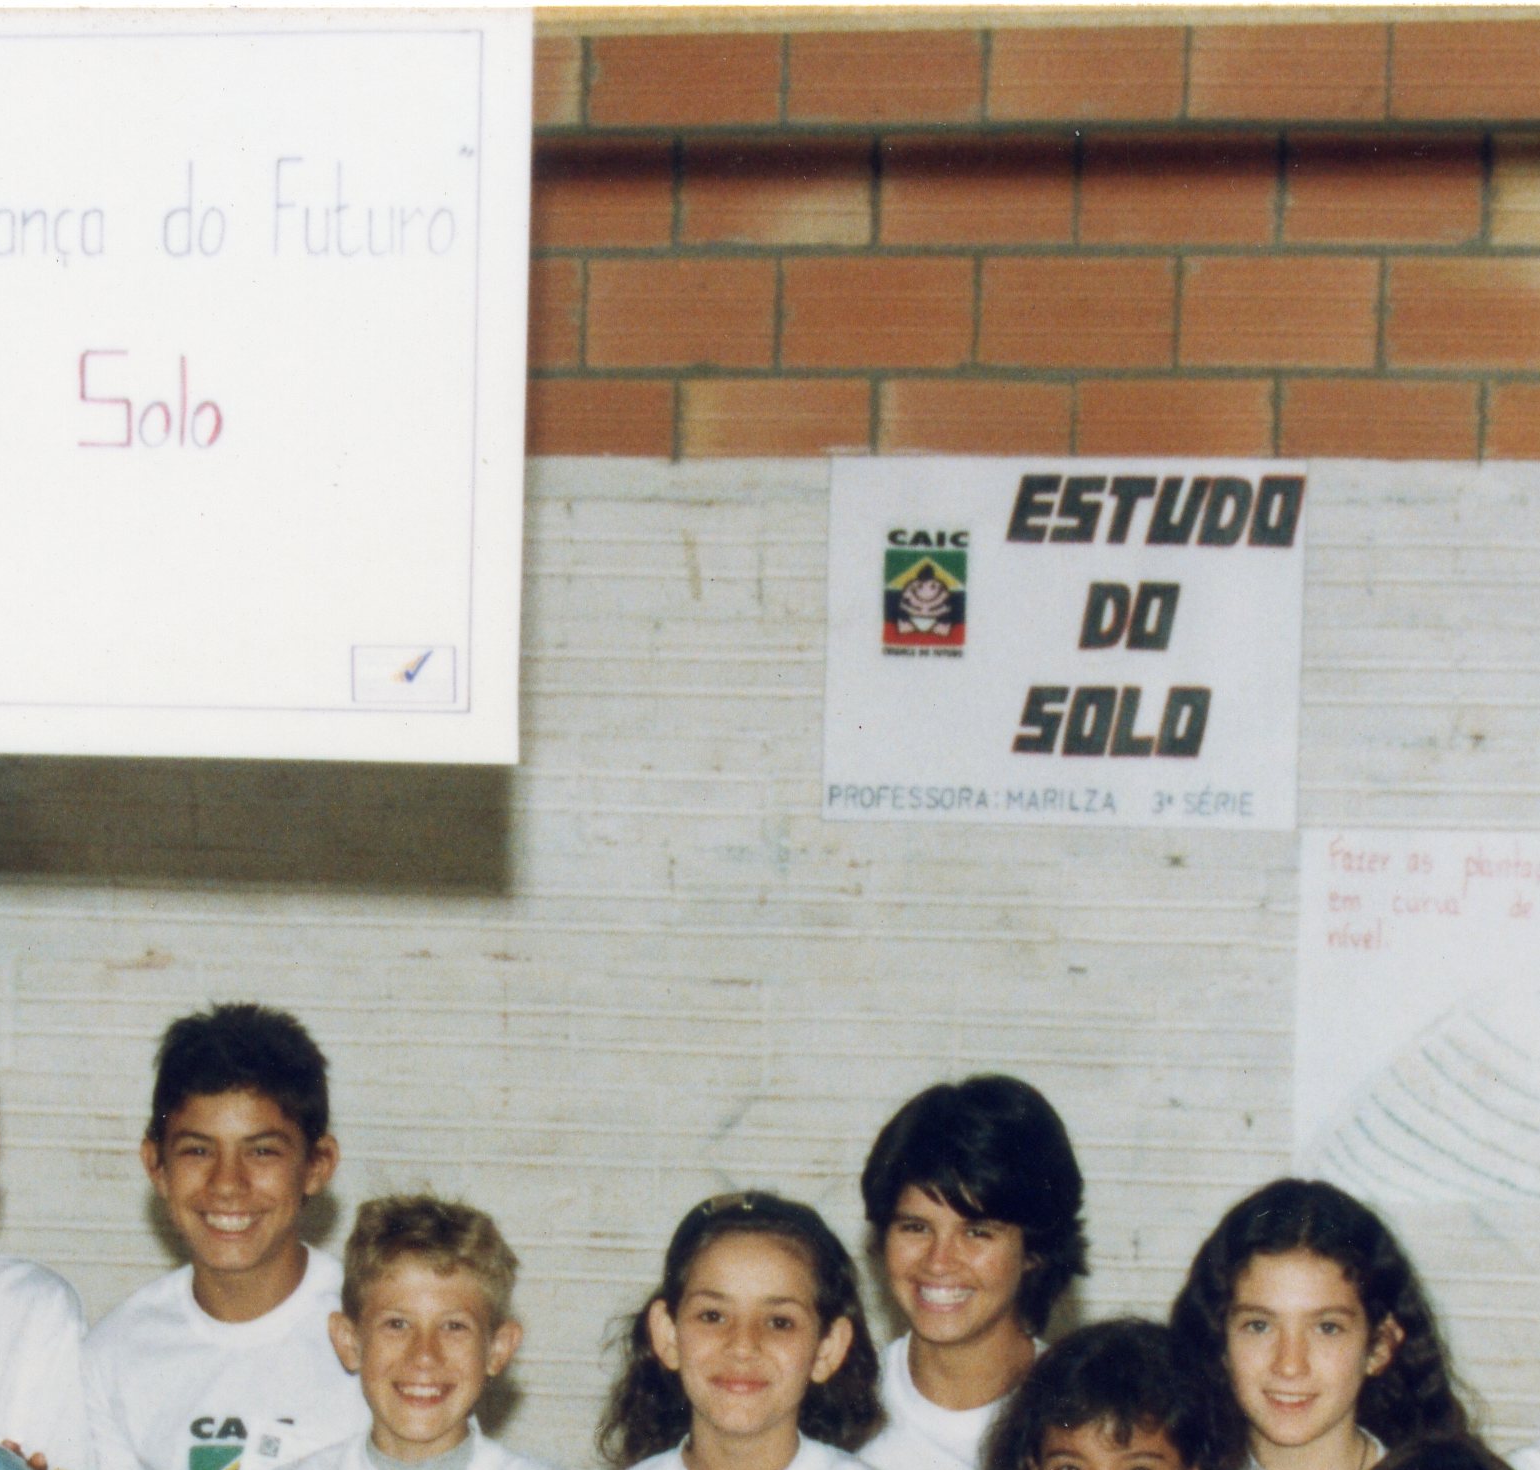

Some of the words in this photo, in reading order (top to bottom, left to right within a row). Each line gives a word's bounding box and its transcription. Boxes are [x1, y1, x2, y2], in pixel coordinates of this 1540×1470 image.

[163, 160, 226, 257] do
[78, 350, 224, 449] Solo
[1006, 474, 1307, 548] ESTUDO
[887, 529, 969, 548] CAIC
[1077, 581, 1182, 652] DO
[1011, 685, 1213, 759] SOLO
[1006, 788, 1117, 816] MARILZA
[1183, 783, 1255, 817] SÉRIE
[1329, 834, 1390, 872] Fazer
[1407, 852, 1433, 874] as
[1509, 890, 1534, 918] de
[1327, 917, 1382, 950] nível
[190, 1417, 248, 1440] CA
